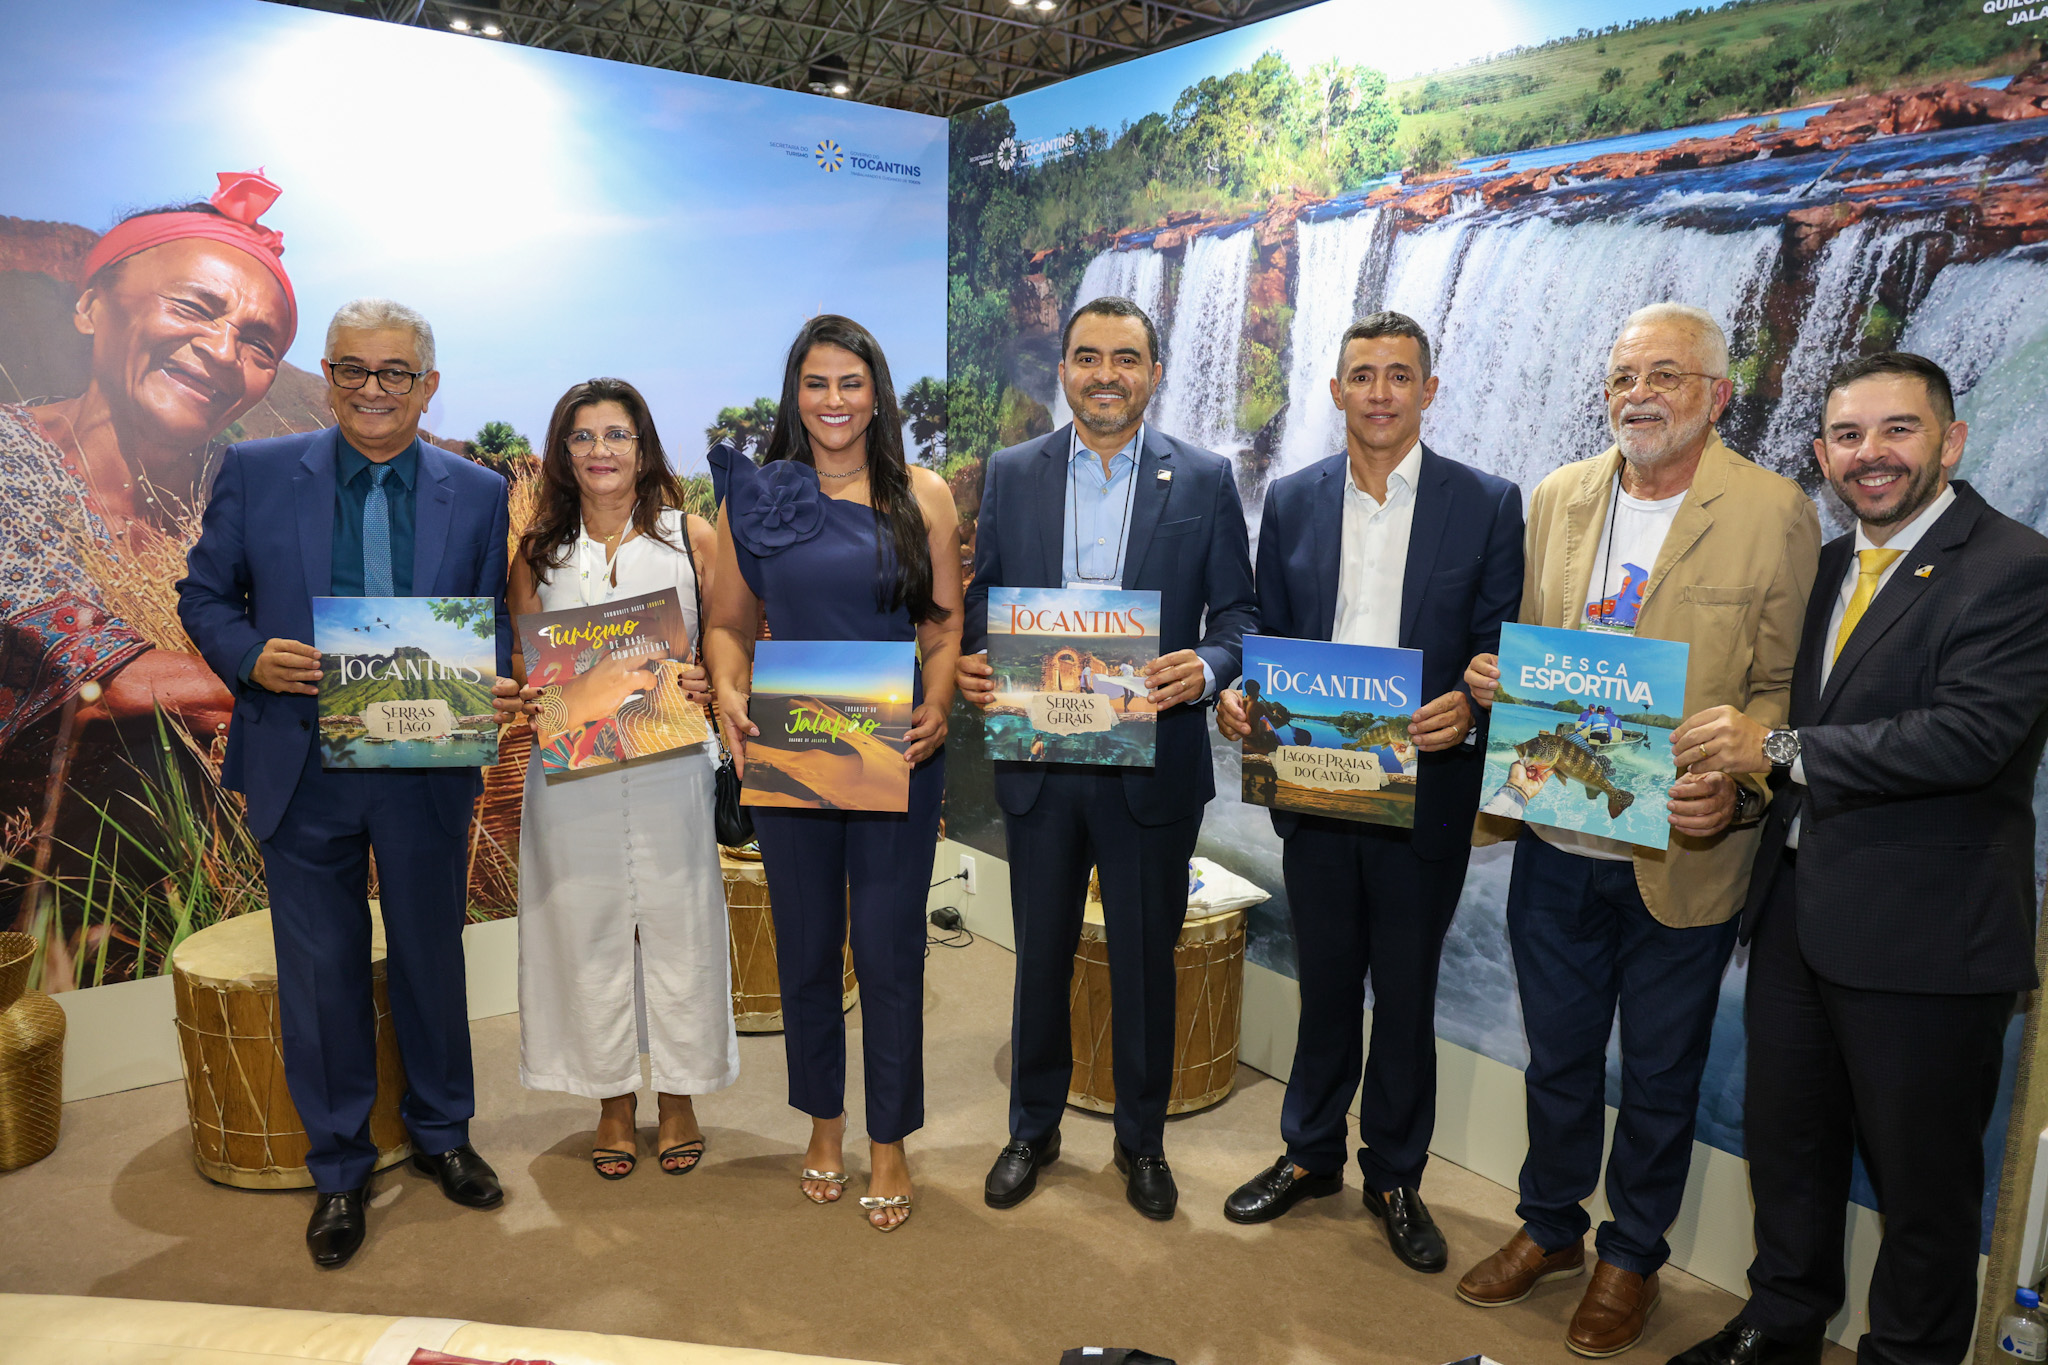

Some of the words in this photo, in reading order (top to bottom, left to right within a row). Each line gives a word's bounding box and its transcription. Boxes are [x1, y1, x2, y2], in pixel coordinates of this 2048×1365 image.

[1983, 0, 2045, 14] QUIL
[1020, 133, 1075, 158] TOCANTINS
[850, 156, 921, 177] TOCANTINS
[1002, 604, 1145, 639] TOCANTINS
[538, 619, 640, 649] Turismo
[609, 640, 619, 650] DE
[624, 634, 646, 647] BASE
[611, 640, 670, 660] COMUNITÁRIA
[330, 654, 482, 685] TOCANTINS
[1545, 653, 1628, 677] PESCA
[1258, 663, 1407, 708] TOCANTINS
[1520, 665, 1654, 706] ESPORTIVA
[381, 705, 435, 721] SERRAS
[1046, 695, 1095, 712] SERRAS
[387, 721, 395, 732] E
[399, 719, 431, 734] LAGO
[785, 707, 881, 743] Jalapão
[1047, 710, 1093, 727] GERAIS
[1283, 749, 1316, 764] LAGOS
[1318, 754, 1325, 765] E
[1325, 753, 1373, 773] PRAIAS
[1295, 766, 1311, 778] DO
[1312, 767, 1360, 784] CANTÃO
